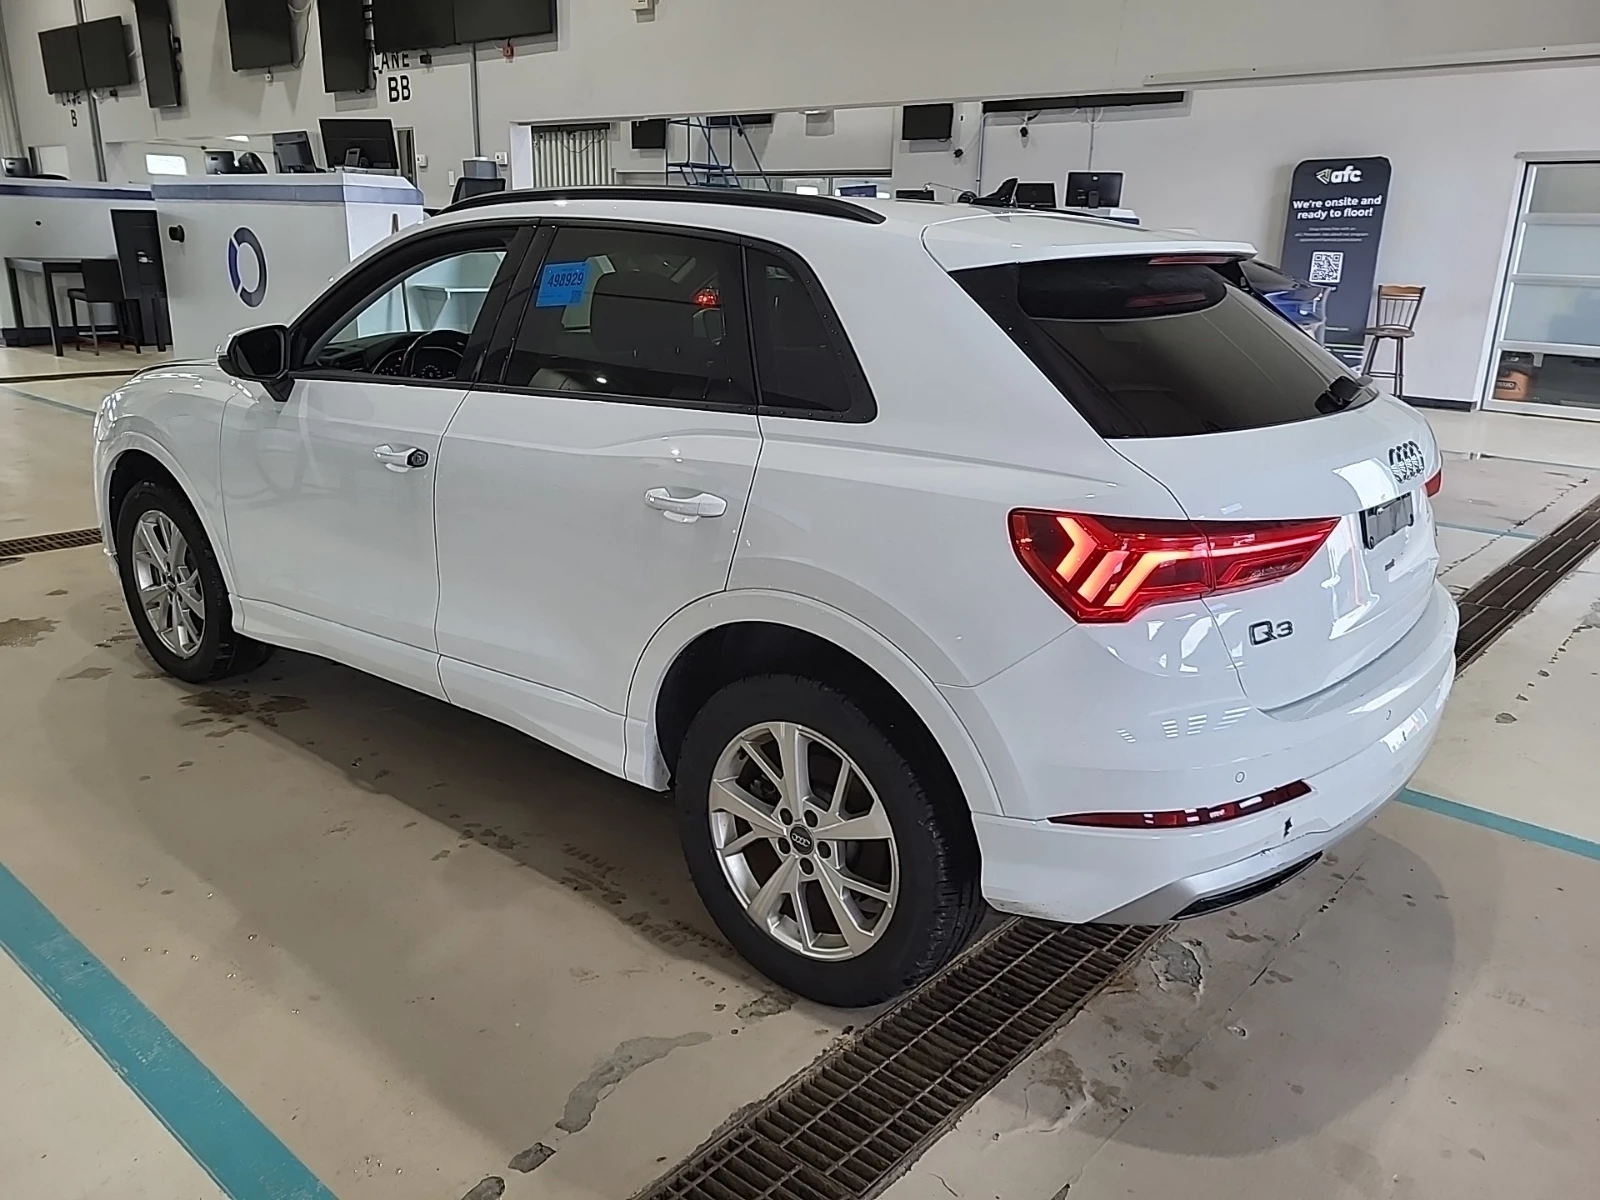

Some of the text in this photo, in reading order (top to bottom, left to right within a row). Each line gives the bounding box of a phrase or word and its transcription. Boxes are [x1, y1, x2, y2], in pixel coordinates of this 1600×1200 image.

[372, 50, 410, 70] LANE
[388, 75, 411, 103] BB
[70, 109, 78, 127] B
[1330, 165, 1363, 184] afc
[1292, 194, 1383, 209] We're onsite and
[1297, 207, 1374, 220] ready to floor!
[547, 271, 585, 289] 498929
[1248, 620, 1294, 646] Q3
